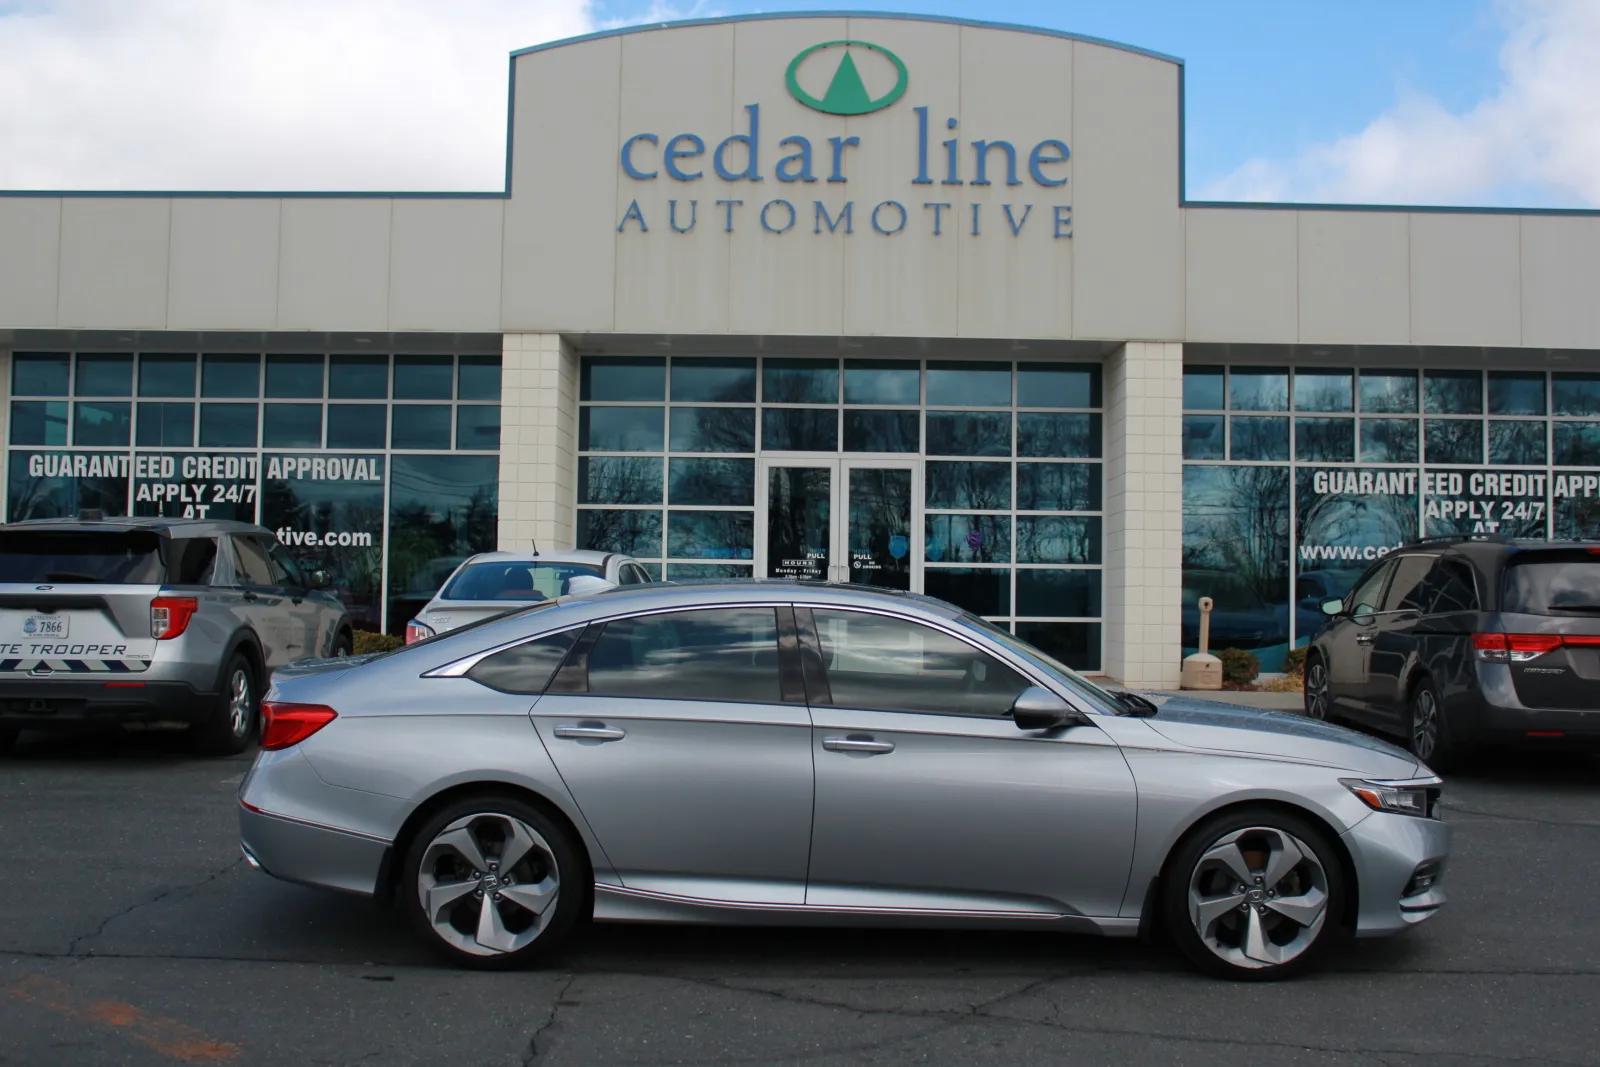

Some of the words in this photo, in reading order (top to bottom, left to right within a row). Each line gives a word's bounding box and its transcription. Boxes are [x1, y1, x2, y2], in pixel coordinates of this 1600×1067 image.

[620, 102, 860, 182] cedar
[911, 106, 1071, 186] line
[617, 199, 1074, 239] AUTOMOTIVE
[29, 454, 175, 478] GUARANTEED
[182, 455, 257, 479] CREDIT
[267, 457, 381, 481] APPROVAL
[136, 483, 207, 502] APPLY
[212, 484, 257, 503] 24/7
[1313, 471, 1463, 496] GUARANTEED
[1469, 473, 1547, 497] CREDIT
[1554, 475, 1600, 498] APP
[183, 504, 210, 519] AT
[1425, 500, 1495, 519] APPLY
[1501, 501, 1545, 520] 24/7
[40, 621, 62, 633] 7866
[30, 644, 127, 655] TROOPER
